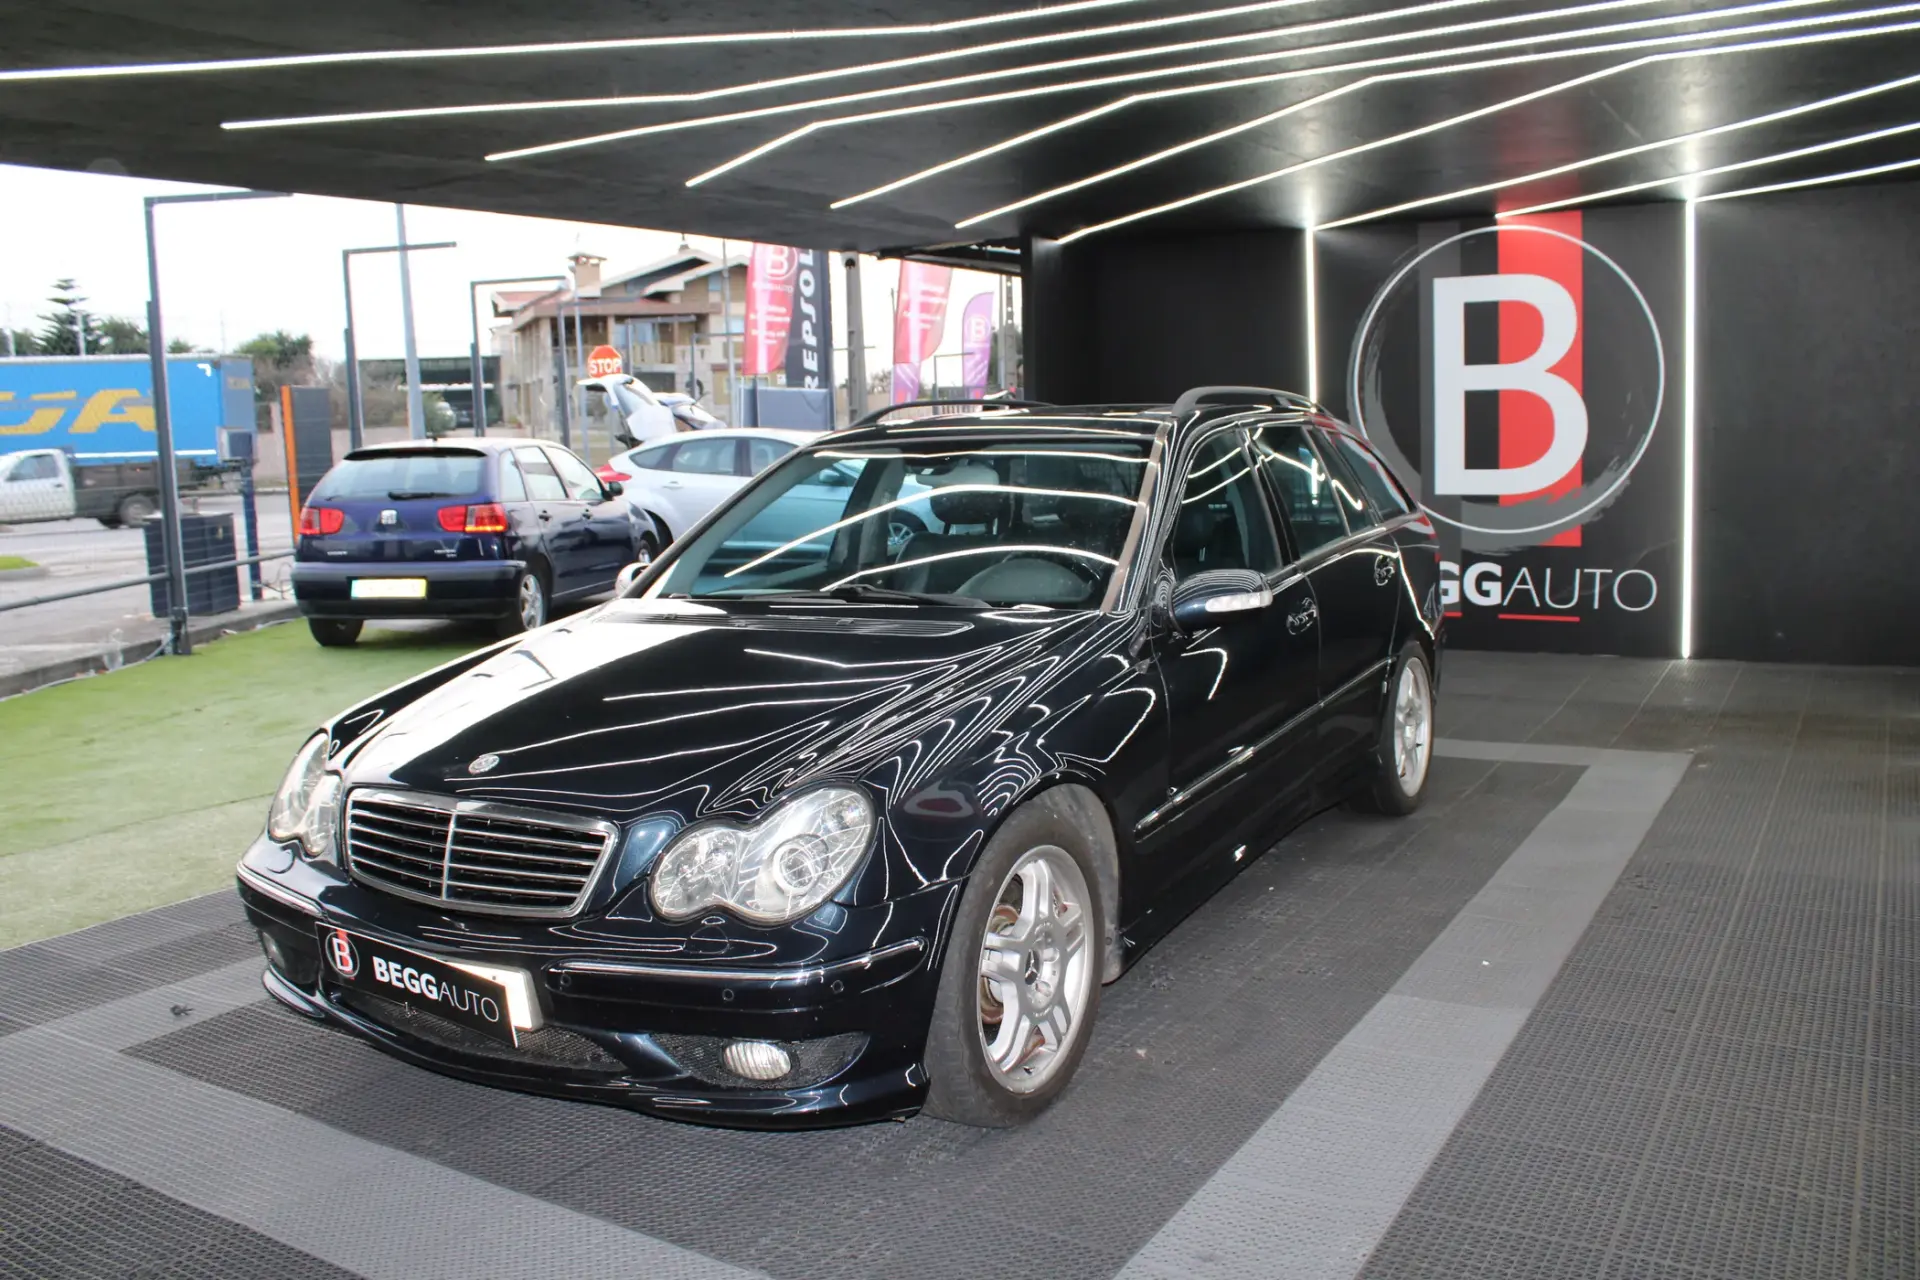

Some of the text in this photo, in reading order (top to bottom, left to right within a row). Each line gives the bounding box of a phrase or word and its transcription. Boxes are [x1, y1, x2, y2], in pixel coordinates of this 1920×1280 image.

[797, 248, 819, 389] REPSOL
[590, 358, 622, 374] STOP
[1433, 274, 1588, 495] B
[1439, 560, 1657, 612] GGAUTO
[332, 937, 354, 972] B
[372, 956, 499, 1022] BEGGAUTO
